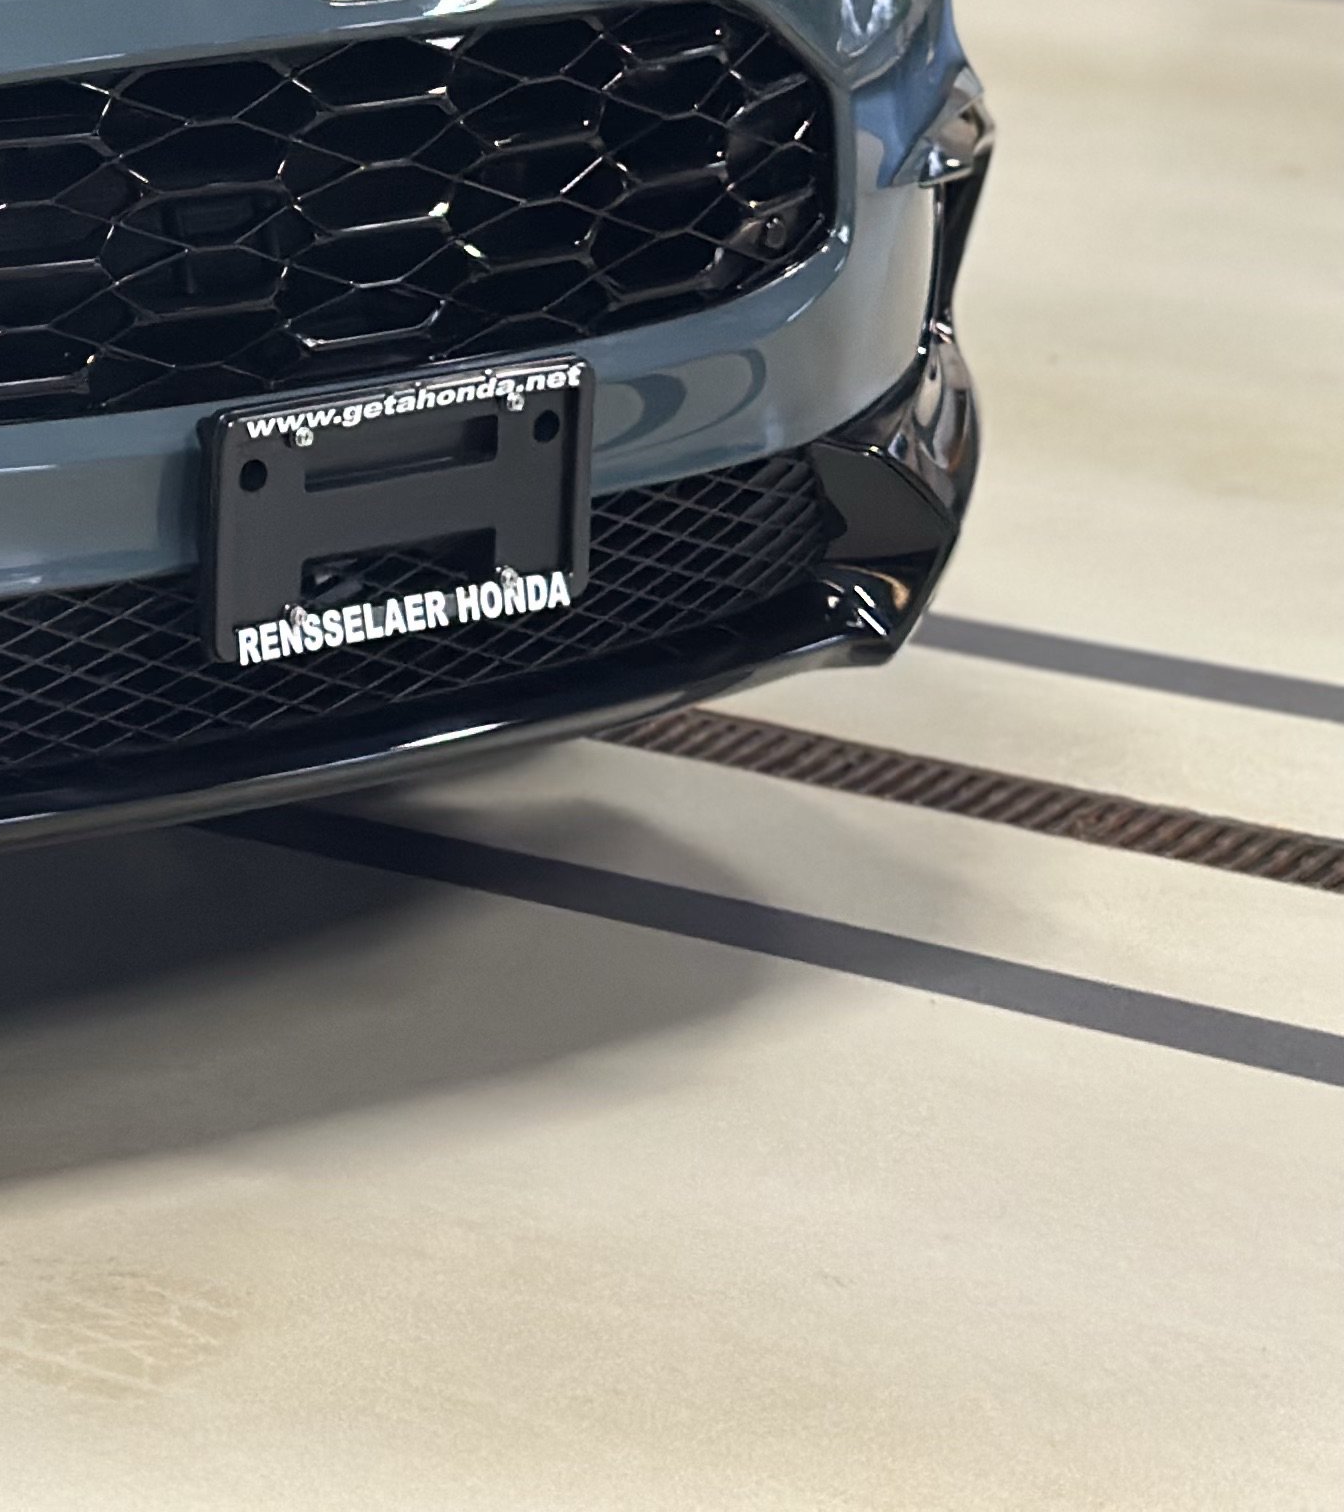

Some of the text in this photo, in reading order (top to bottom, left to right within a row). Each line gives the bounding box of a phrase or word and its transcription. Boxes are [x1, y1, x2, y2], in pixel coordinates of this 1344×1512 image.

[246, 364, 582, 439] www.getahonda.net
[238, 571, 571, 666] RENSSELAER HONDA
